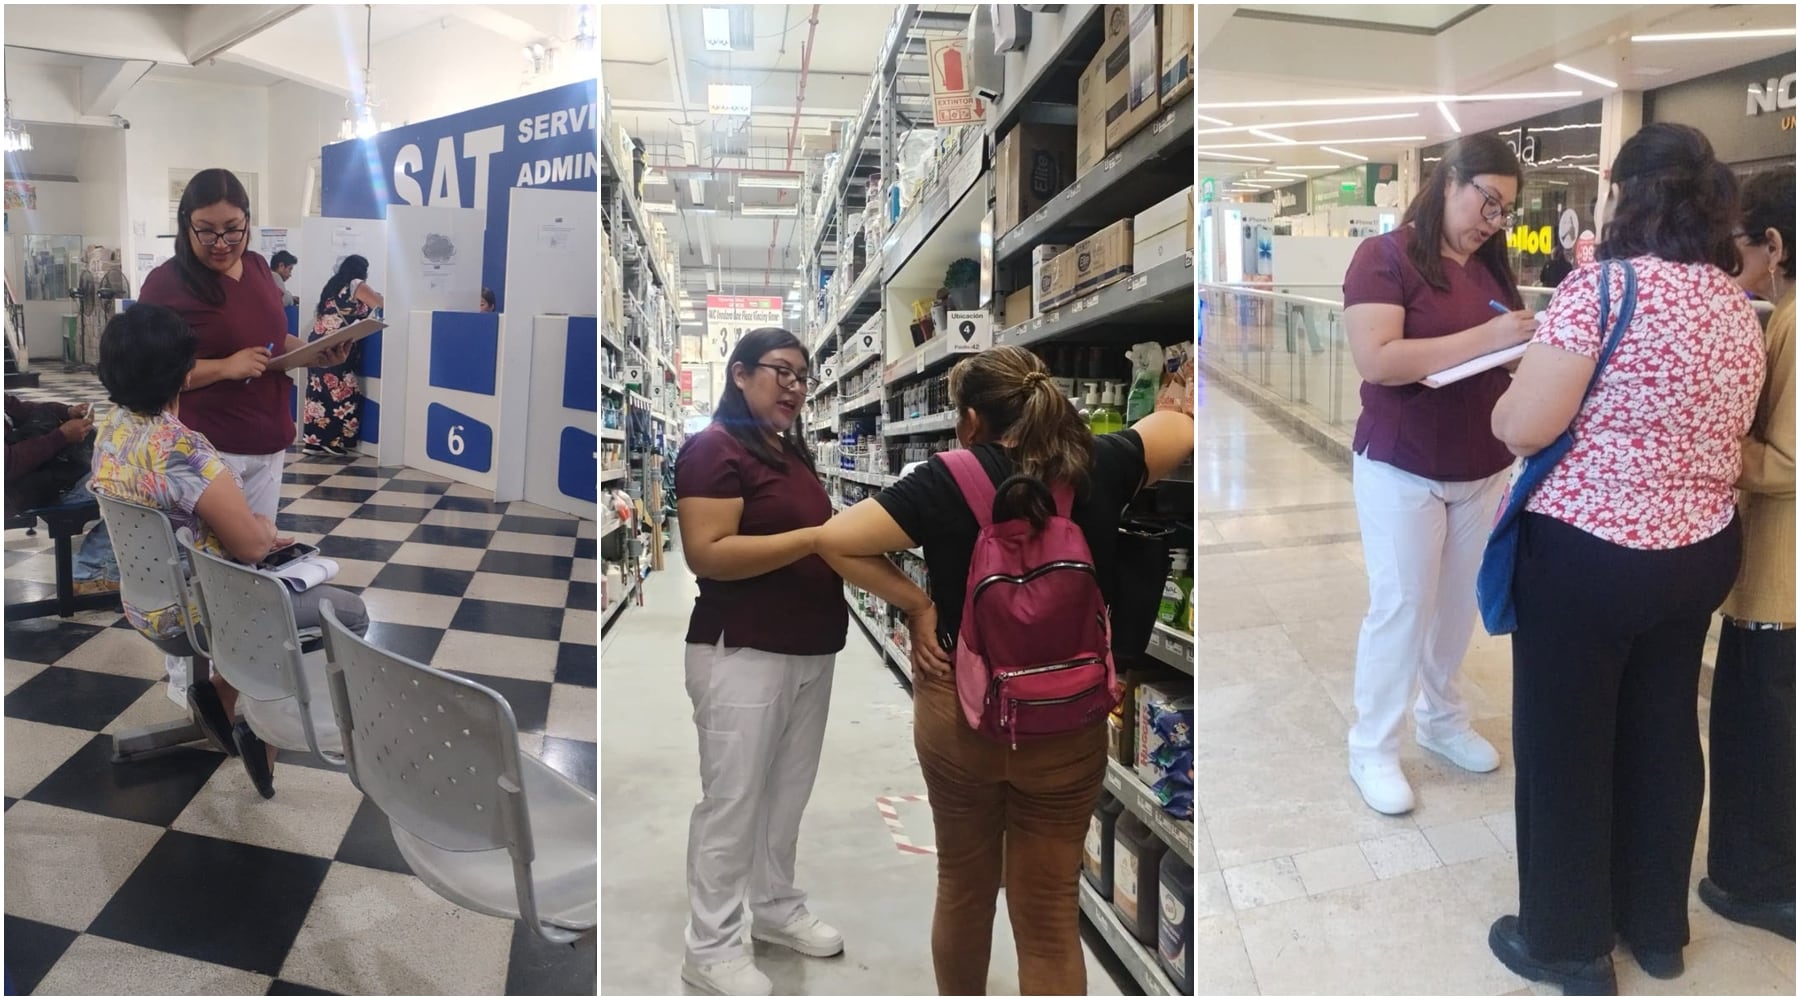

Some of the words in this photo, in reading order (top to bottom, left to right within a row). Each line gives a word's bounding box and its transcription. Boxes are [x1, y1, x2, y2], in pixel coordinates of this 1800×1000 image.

[938, 98, 974, 106] EXTINTOR
[518, 103, 597, 143] SERVI
[394, 125, 505, 209] SAT
[1034, 155, 1049, 193] Elite
[963, 325, 970, 334] 4
[447, 425, 465, 456] 6
